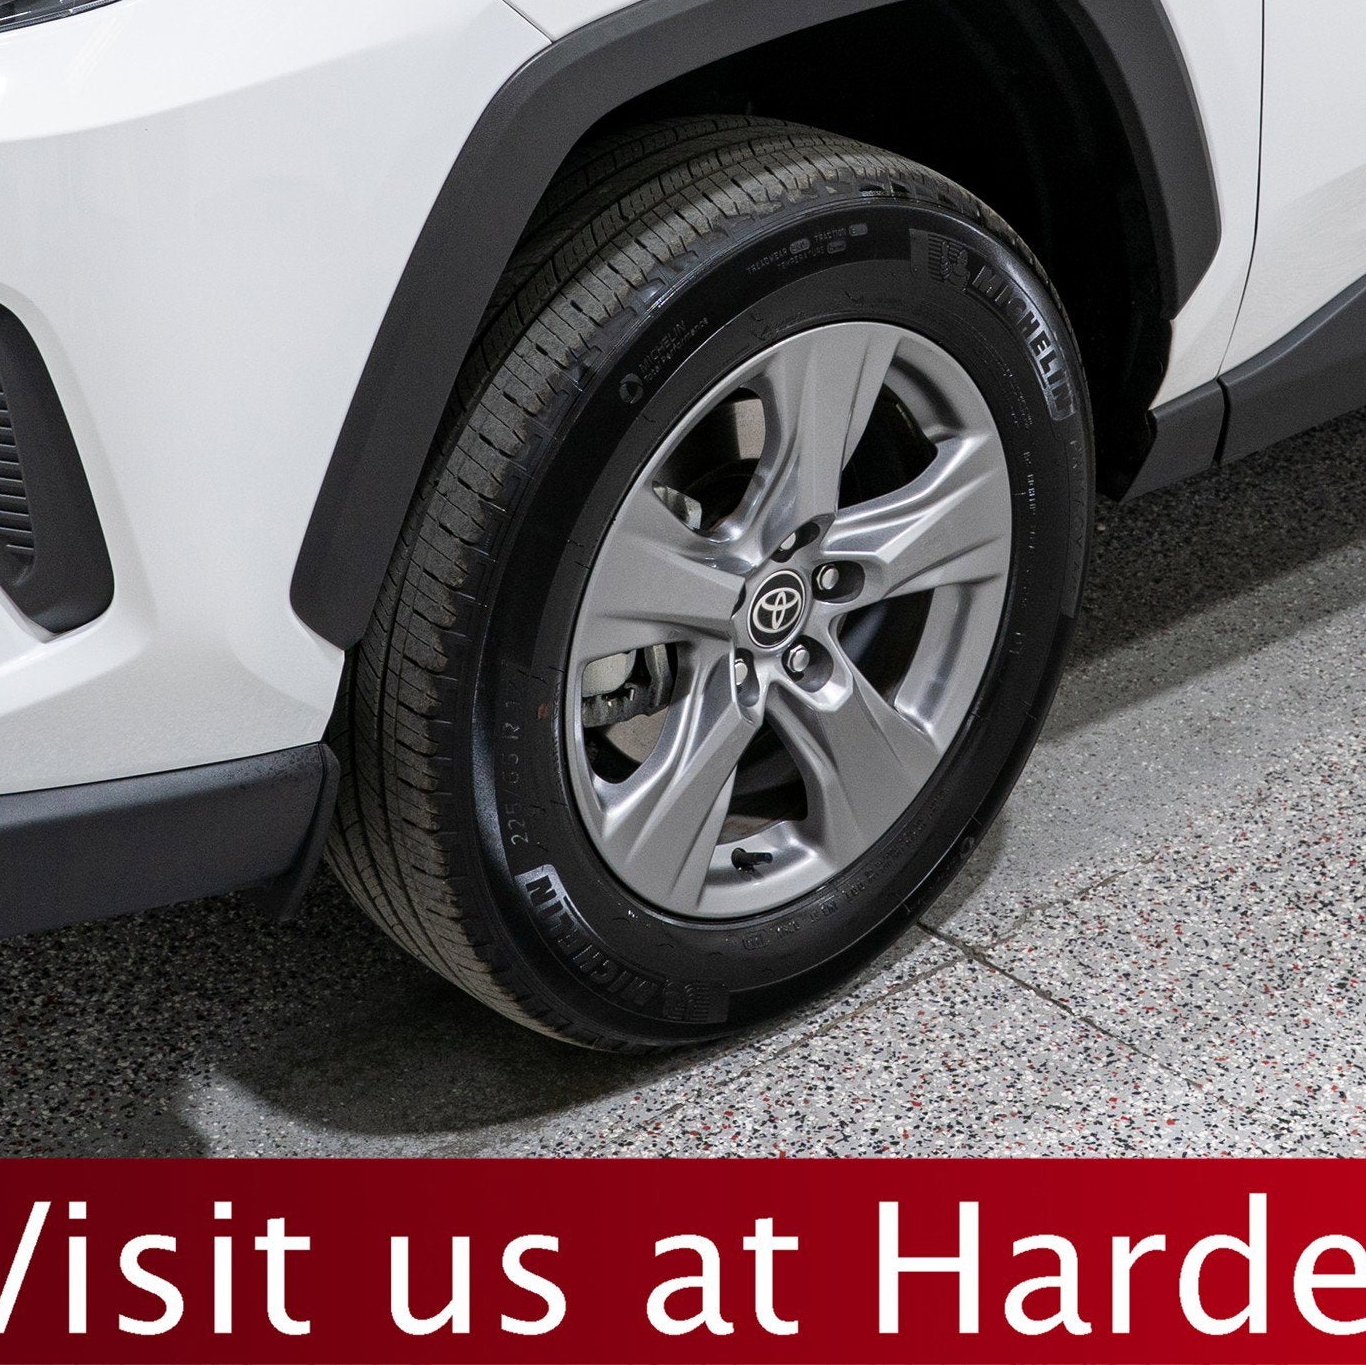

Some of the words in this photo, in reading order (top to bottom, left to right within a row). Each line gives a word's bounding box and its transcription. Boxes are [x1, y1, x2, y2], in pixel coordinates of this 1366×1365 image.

[638, 319, 687, 375] MICHELIN
[971, 264, 1074, 413] MICHELIN
[525, 875, 660, 1007] MICHELIN
